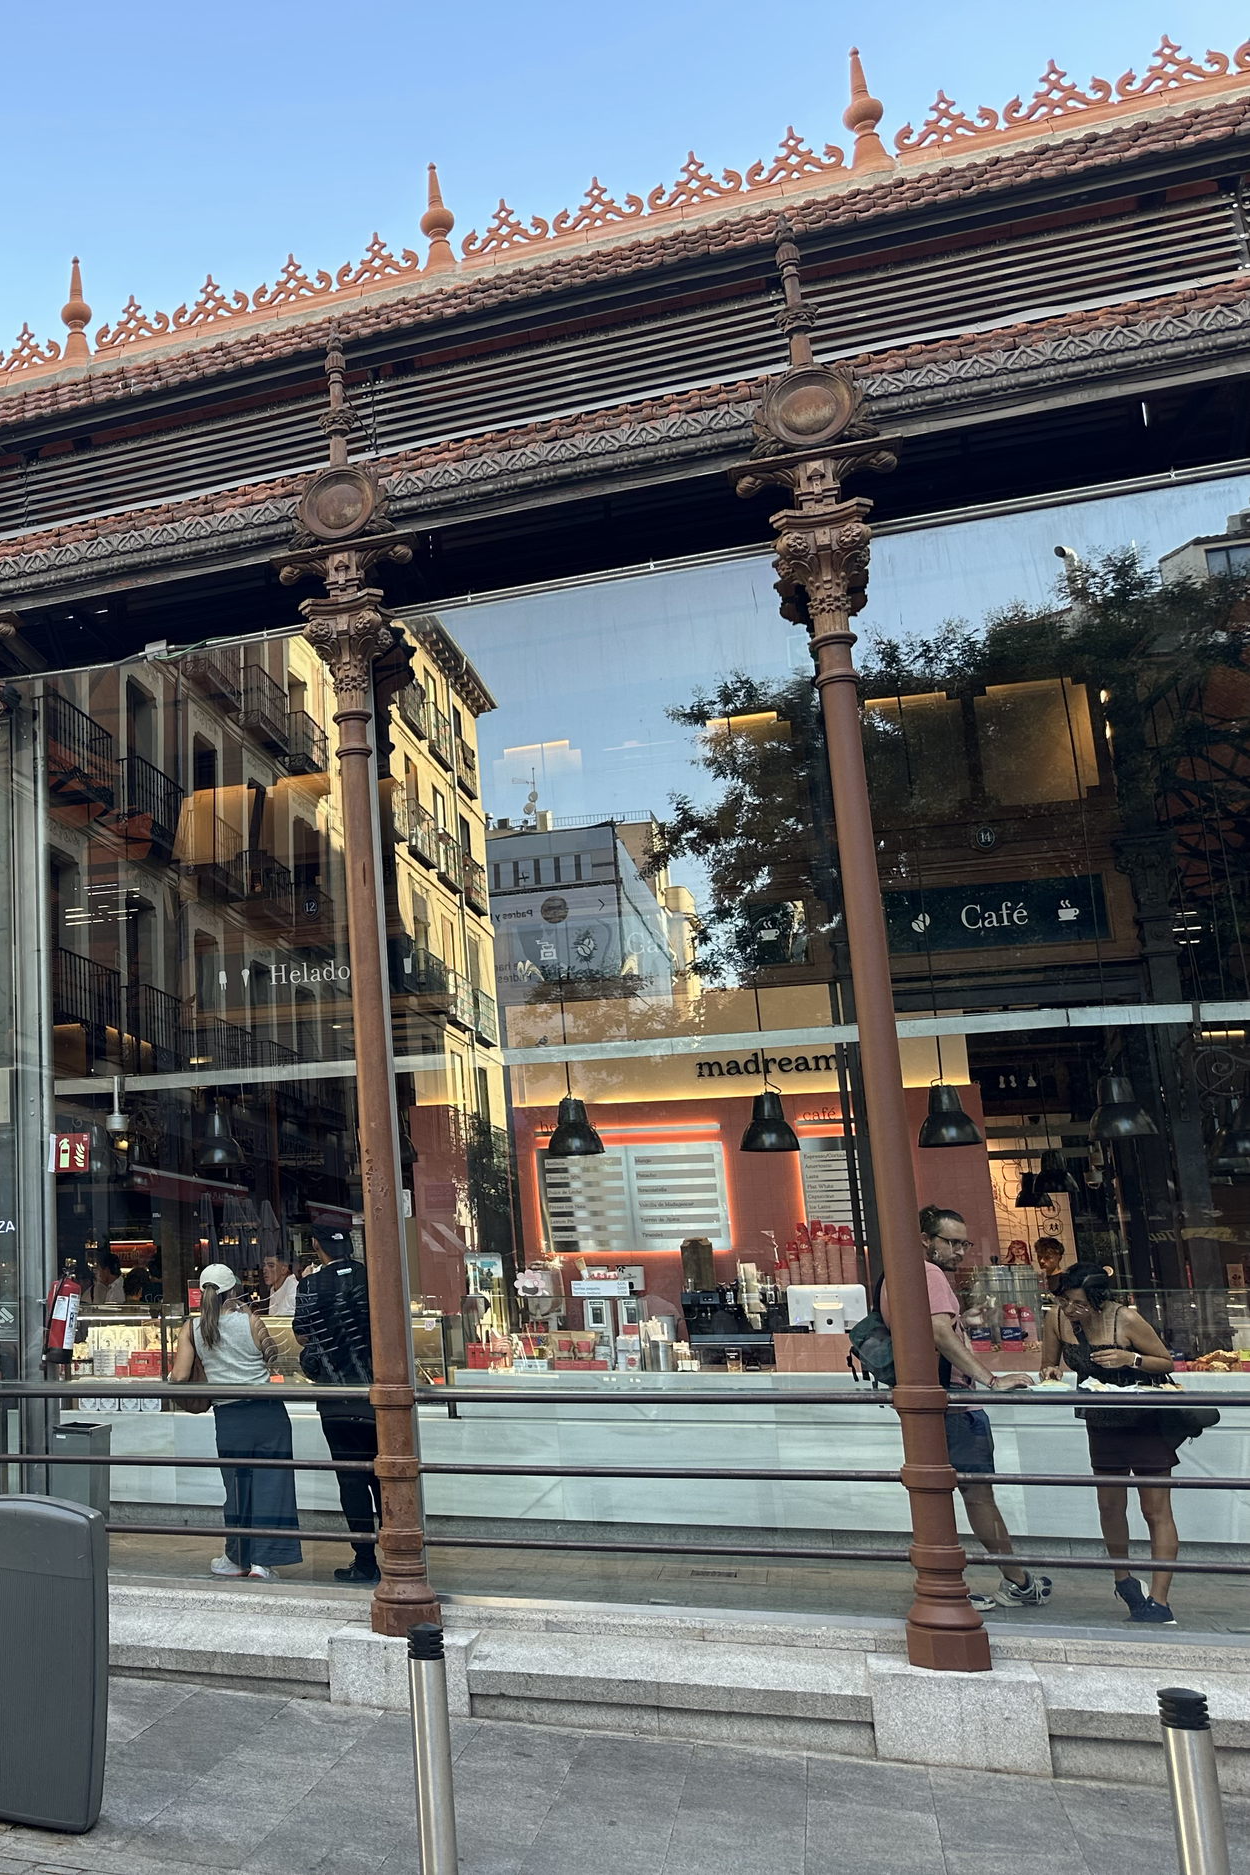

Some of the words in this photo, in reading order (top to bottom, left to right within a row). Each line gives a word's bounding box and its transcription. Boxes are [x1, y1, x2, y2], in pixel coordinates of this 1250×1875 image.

[979, 832, 992, 843] 14
[305, 901, 316, 912] 12
[961, 901, 1029, 929] Café
[802, 1107, 836, 1121] café
